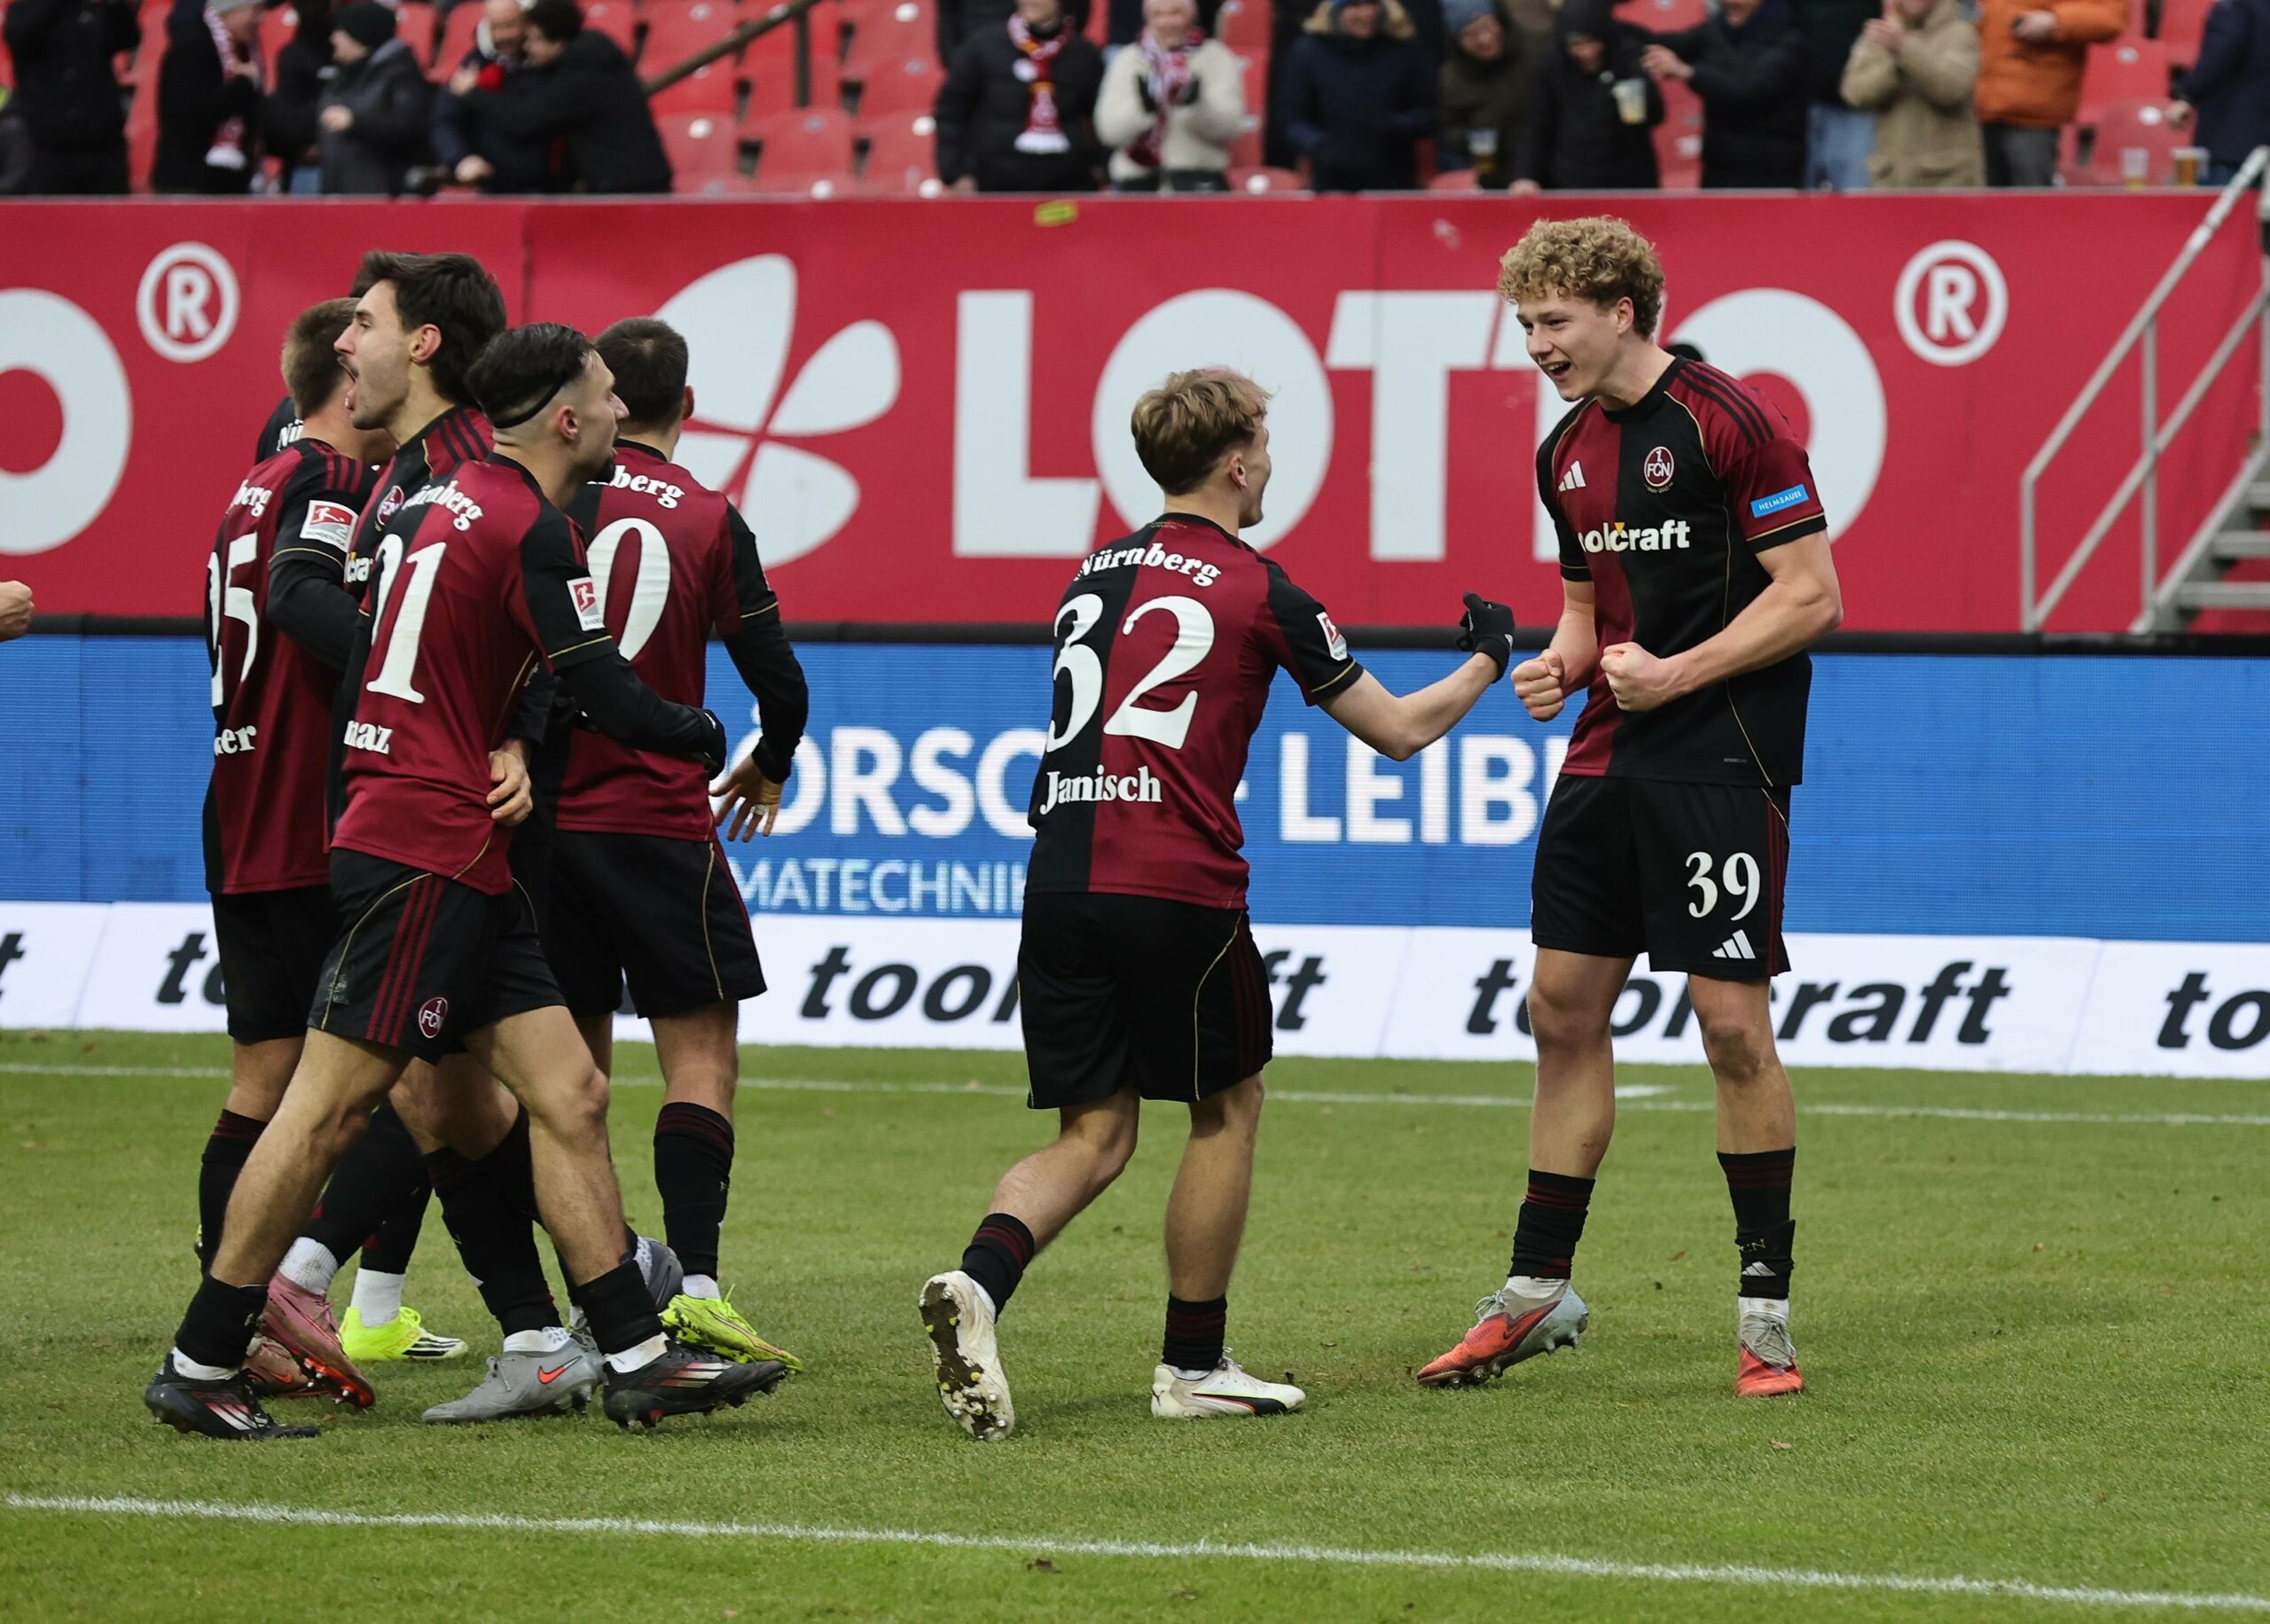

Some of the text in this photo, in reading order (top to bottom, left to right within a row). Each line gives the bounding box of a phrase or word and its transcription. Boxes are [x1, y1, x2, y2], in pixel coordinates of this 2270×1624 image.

[225, 479, 273, 518] berg
[587, 465, 685, 509] berg
[1578, 519, 1691, 553] olcraft
[1046, 593, 1215, 750] 32
[1039, 764, 1162, 816] Janisch
[1686, 851, 1760, 921] 39
